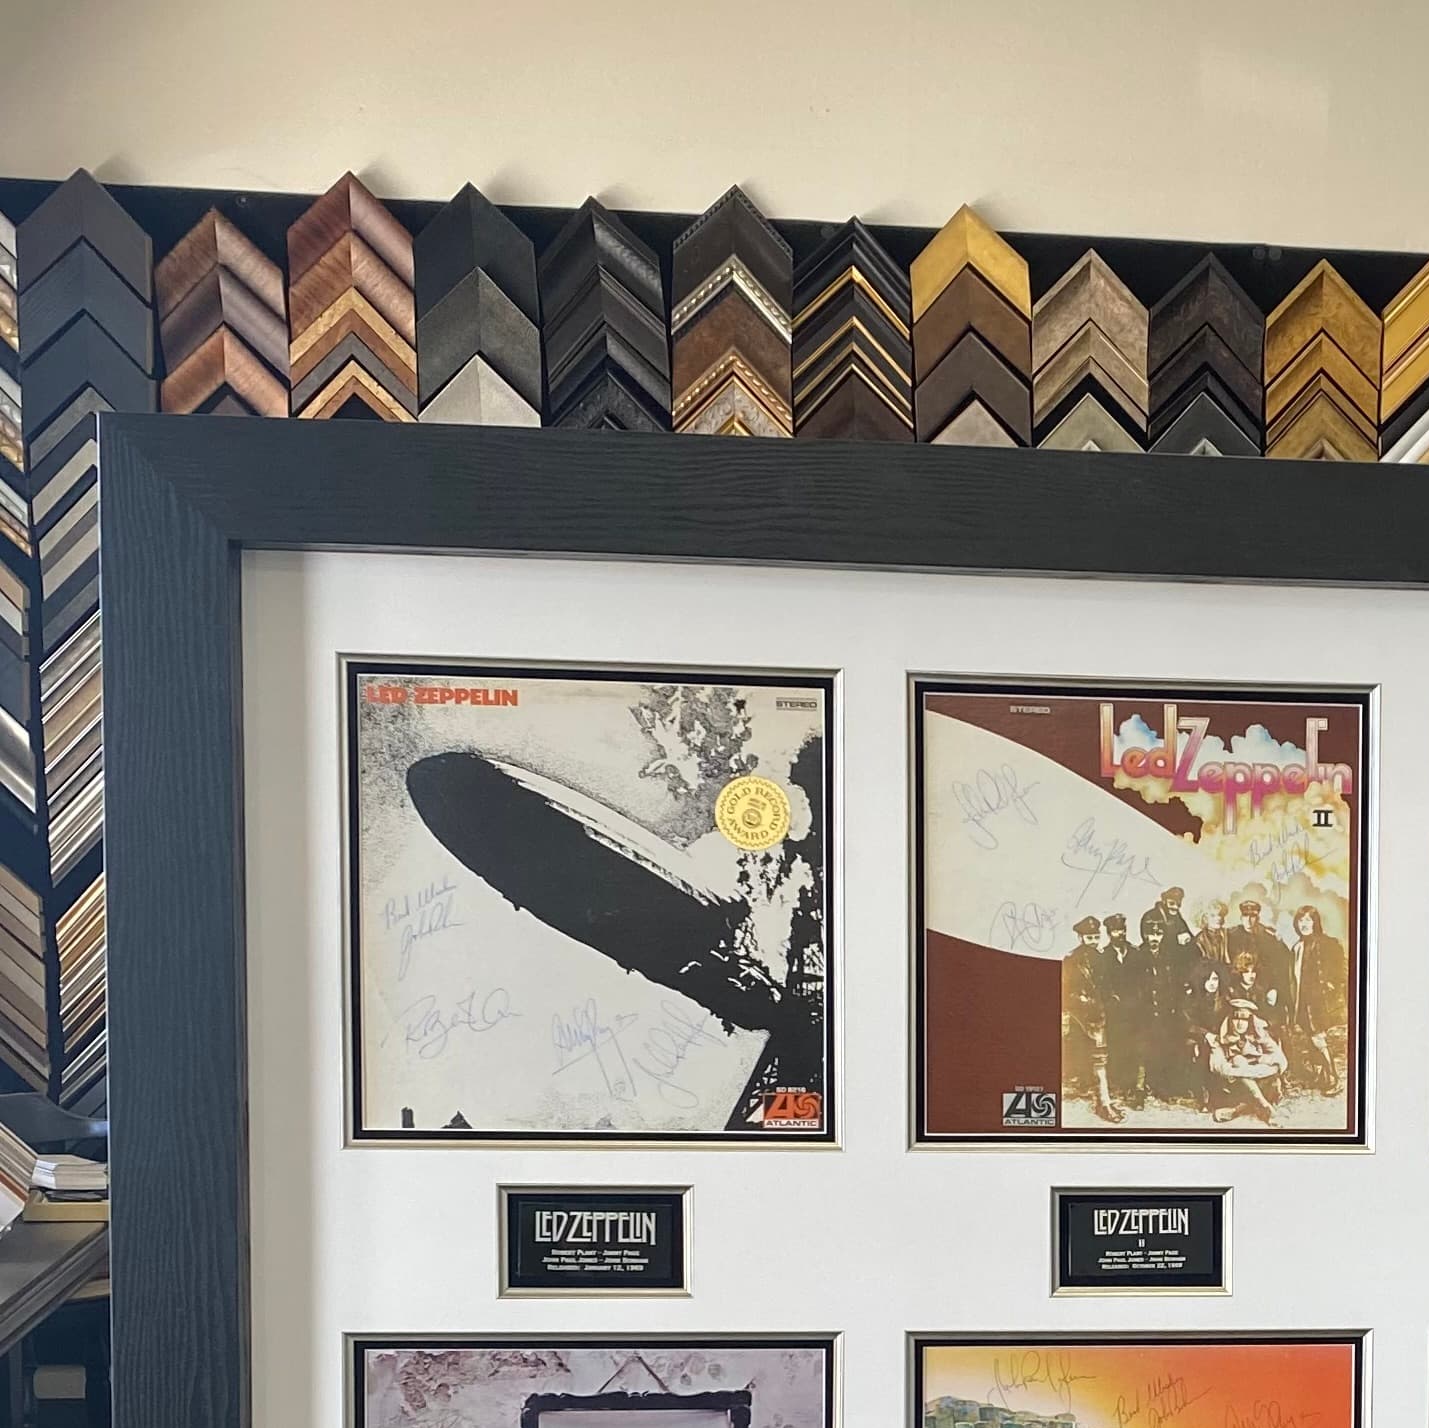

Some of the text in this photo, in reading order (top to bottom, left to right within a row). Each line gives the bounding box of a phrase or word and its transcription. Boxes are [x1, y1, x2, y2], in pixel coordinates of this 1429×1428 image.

[367, 685, 519, 706] LED ZEPPELIN
[776, 699, 818, 709] STEREO
[1009, 705, 1051, 714] STEREO
[726, 786, 782, 831] GOLD RECORD
[1312, 809, 1334, 828] II
[727, 817, 770, 841] AWARD
[535, 1211, 657, 1245] LED ZEPPELIN
[1094, 1208, 1189, 1235] LED ZEPPELIN
